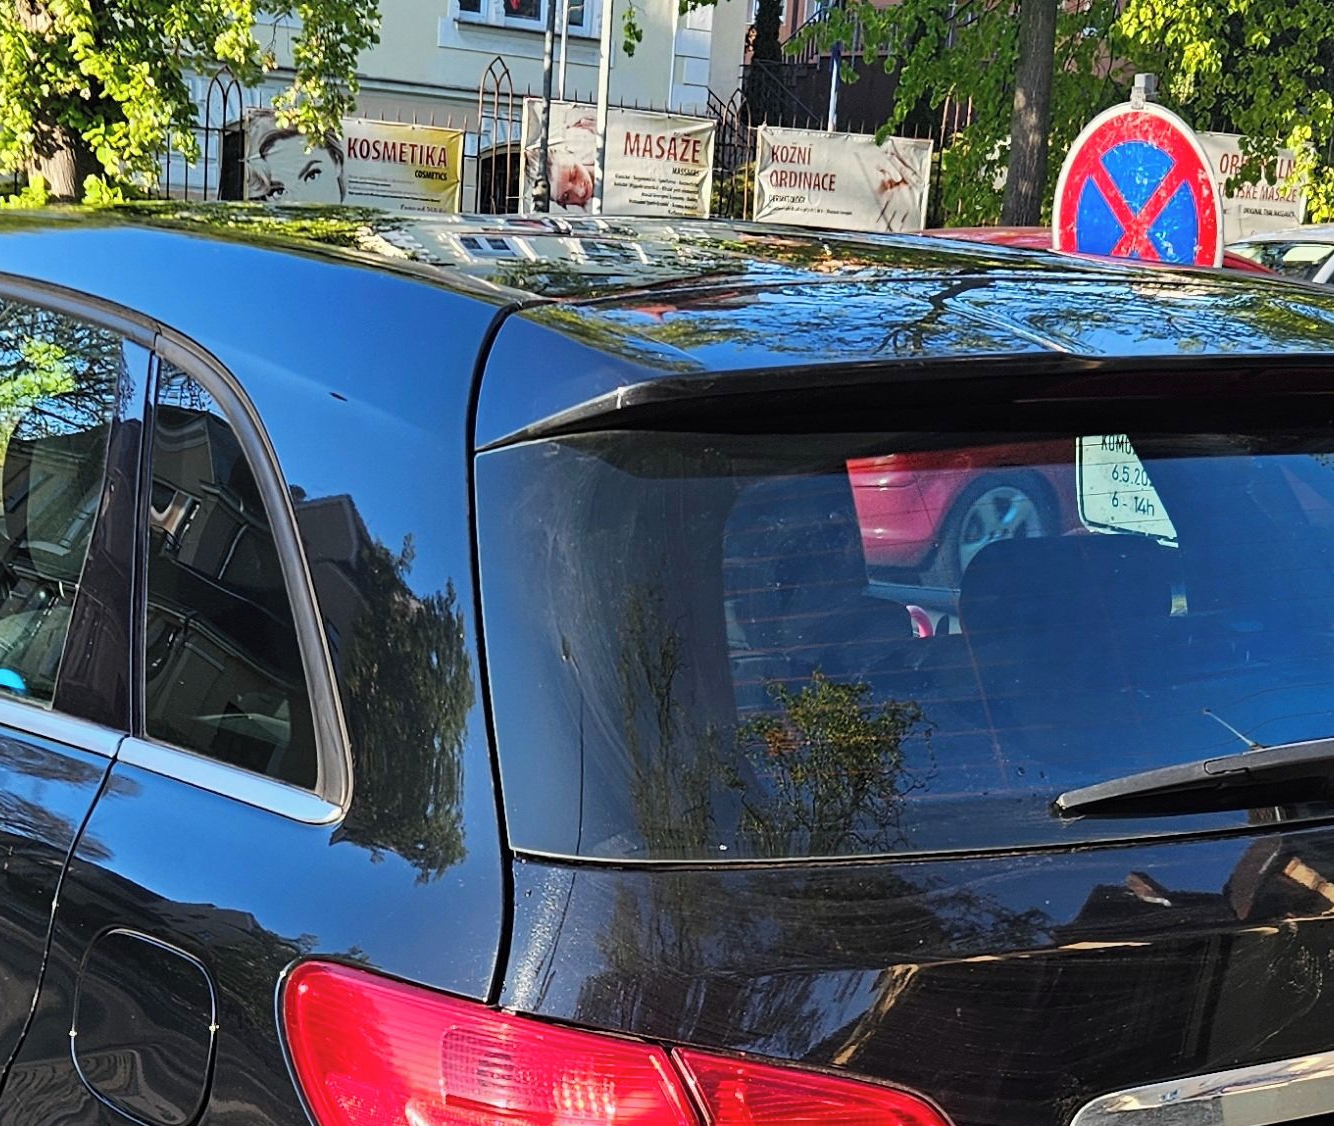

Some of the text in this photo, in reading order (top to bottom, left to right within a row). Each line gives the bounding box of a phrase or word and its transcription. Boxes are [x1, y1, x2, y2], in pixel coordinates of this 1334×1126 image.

[348, 138, 447, 167] KOSMETIKA
[624, 131, 701, 163] MASÁŽE
[771, 142, 813, 165] KOŽNÍ
[414, 169, 448, 181] COSMETICS
[769, 169, 836, 191] ORDINACE
[1112, 464, 1152, 487] 6.5.20
[1112, 491, 1119, 508] 6
[1133, 496, 1155, 516] 14h
